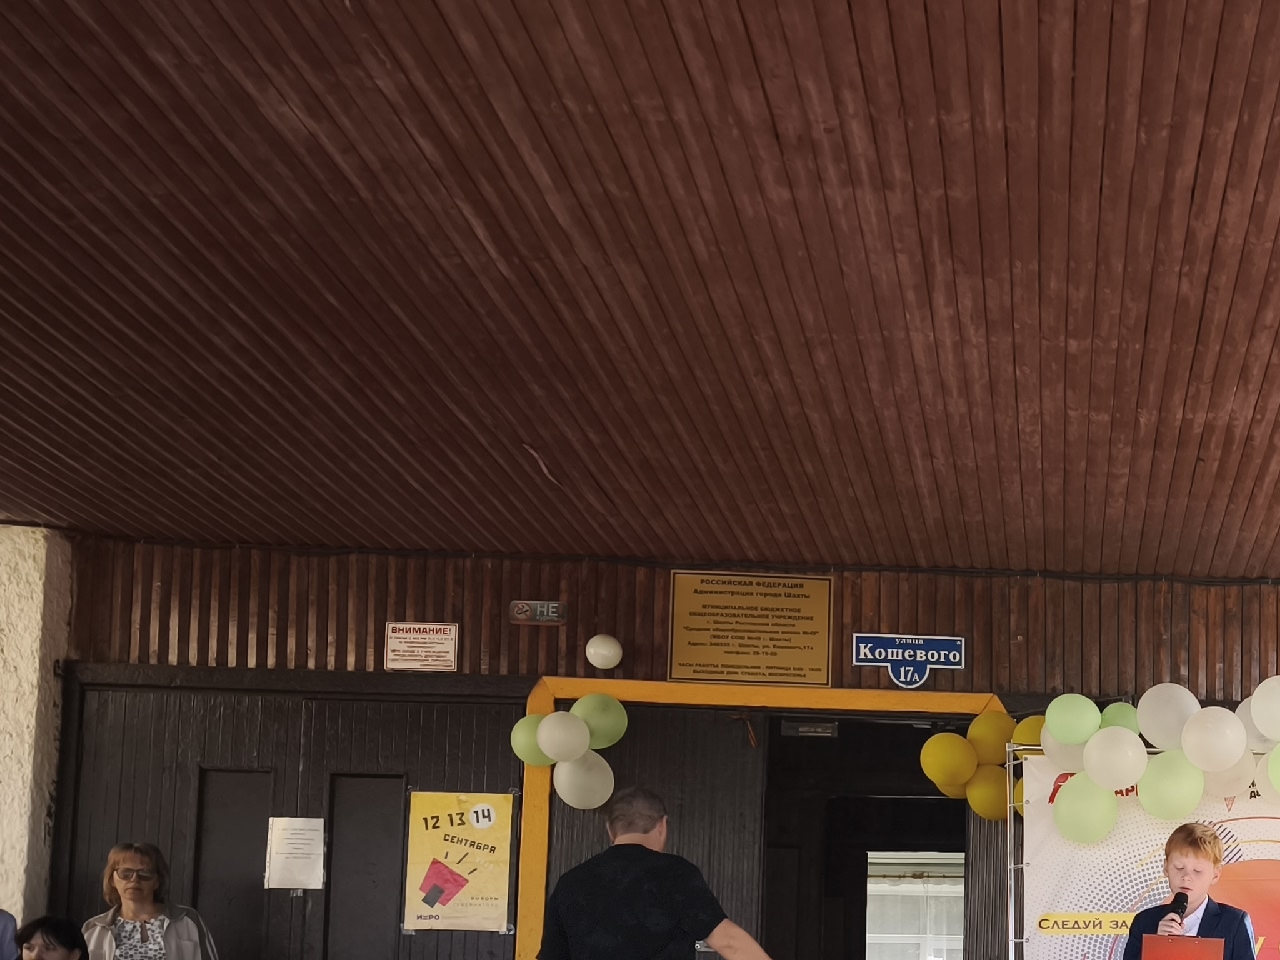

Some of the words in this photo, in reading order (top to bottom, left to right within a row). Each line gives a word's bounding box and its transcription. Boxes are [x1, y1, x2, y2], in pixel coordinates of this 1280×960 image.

[700, 579, 753, 587] РОССИЙСКАЯ
[756, 581, 804, 589] ФЕДЕРАЦИЯ
[537, 603, 559, 616] НЕ
[391, 626, 452, 636] ВНИМАНИЕ!
[858, 643, 961, 662] Кошевого
[422, 815, 441, 831] 12
[447, 812, 466, 827] 13
[473, 808, 492, 824] 14
[443, 833, 497, 854] СЕНТЯБРЯ
